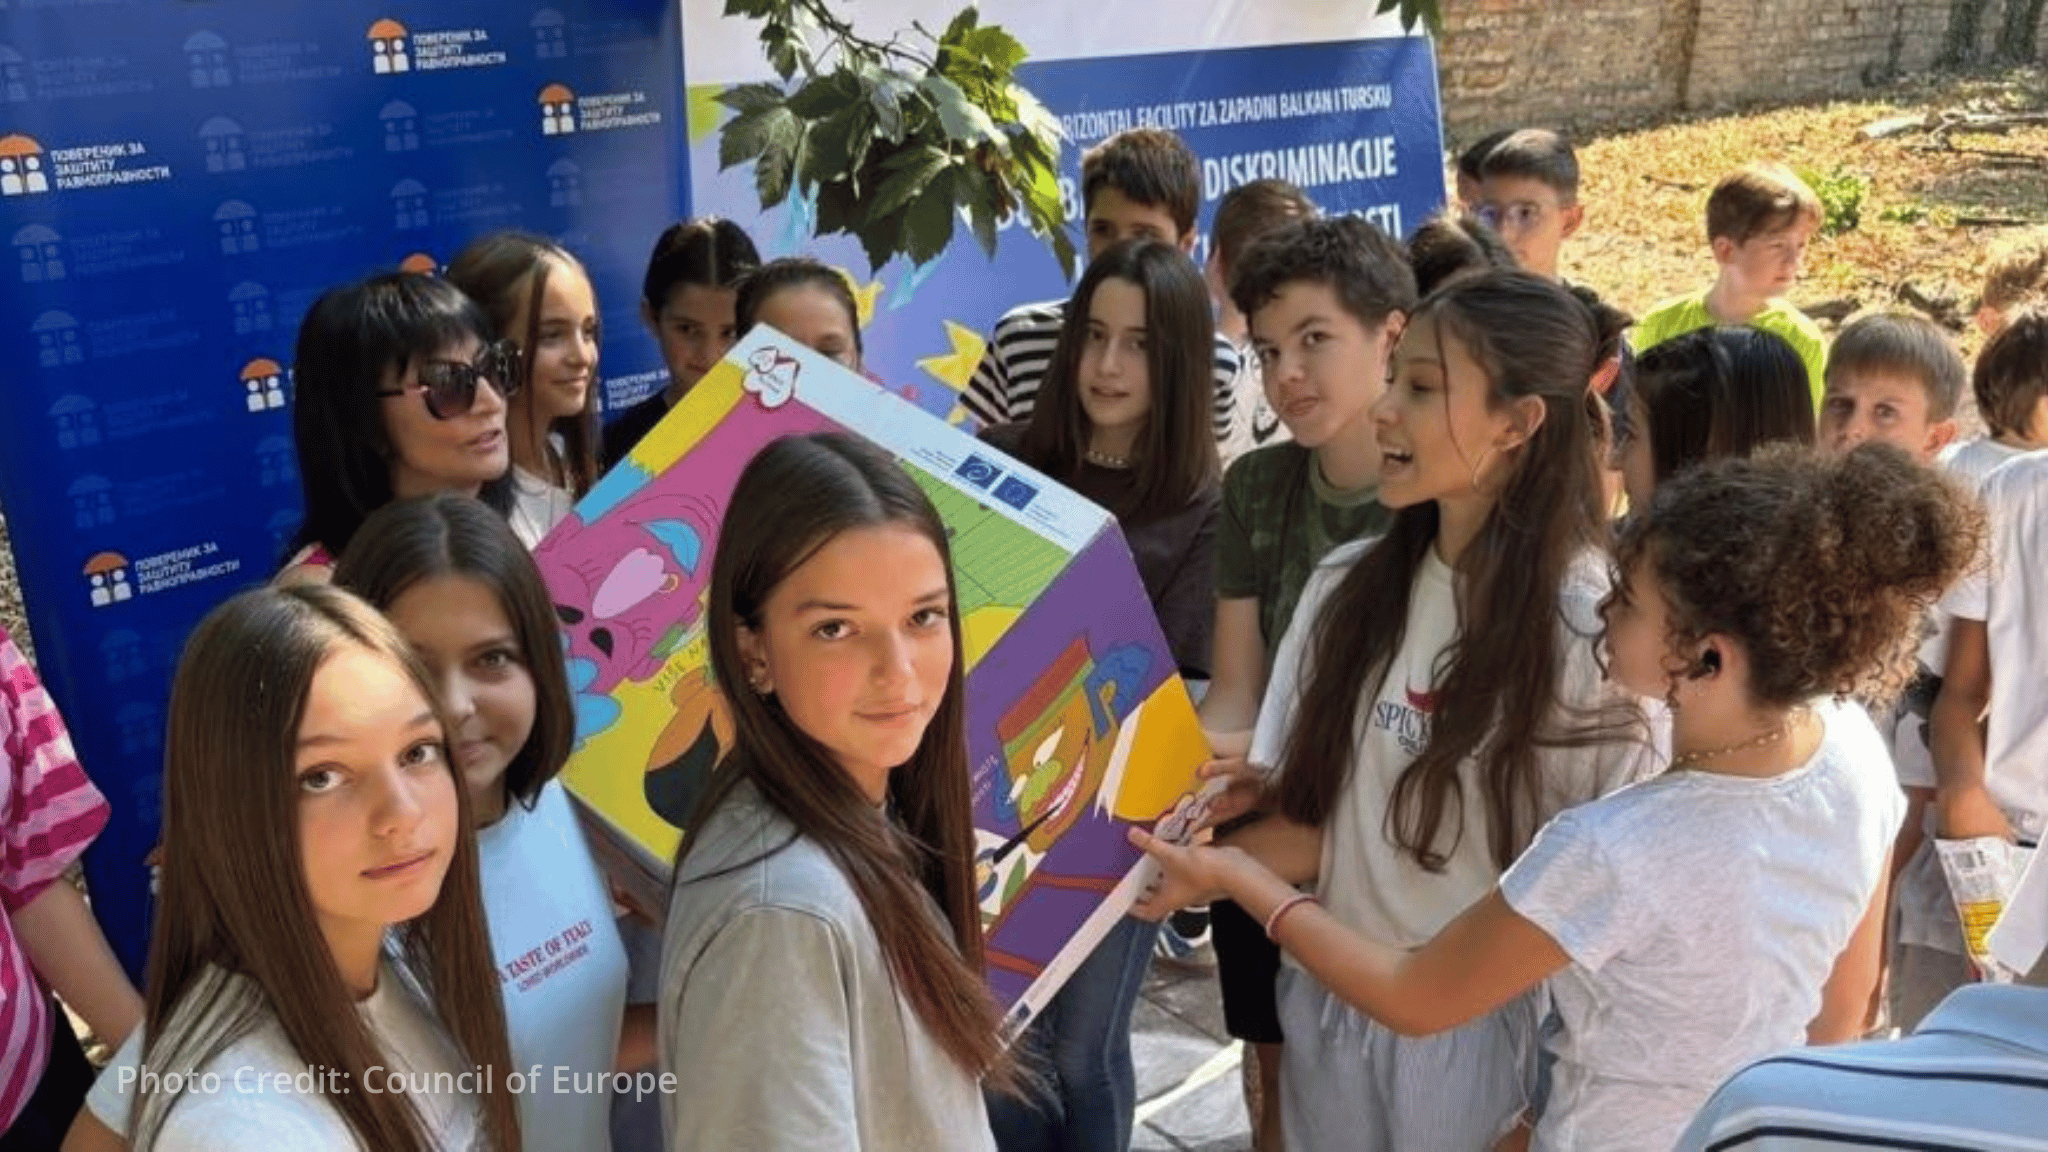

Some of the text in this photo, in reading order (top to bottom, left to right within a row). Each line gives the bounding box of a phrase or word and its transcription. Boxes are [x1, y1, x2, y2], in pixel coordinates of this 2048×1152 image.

[1062, 83, 1392, 140] RIZONTAL FACILITY ZA ZAPADNI BALKAN I TURSKU
[50, 142, 146, 163] ПОВЕРЕНИК ЗА
[55, 158, 116, 177] ЗАШТИТУ
[56, 166, 171, 190] РАВНОПРАВНОСТИ
[1203, 137, 1398, 201] DISKRIMINACIJE
[505, 946, 546, 979] TASTE
